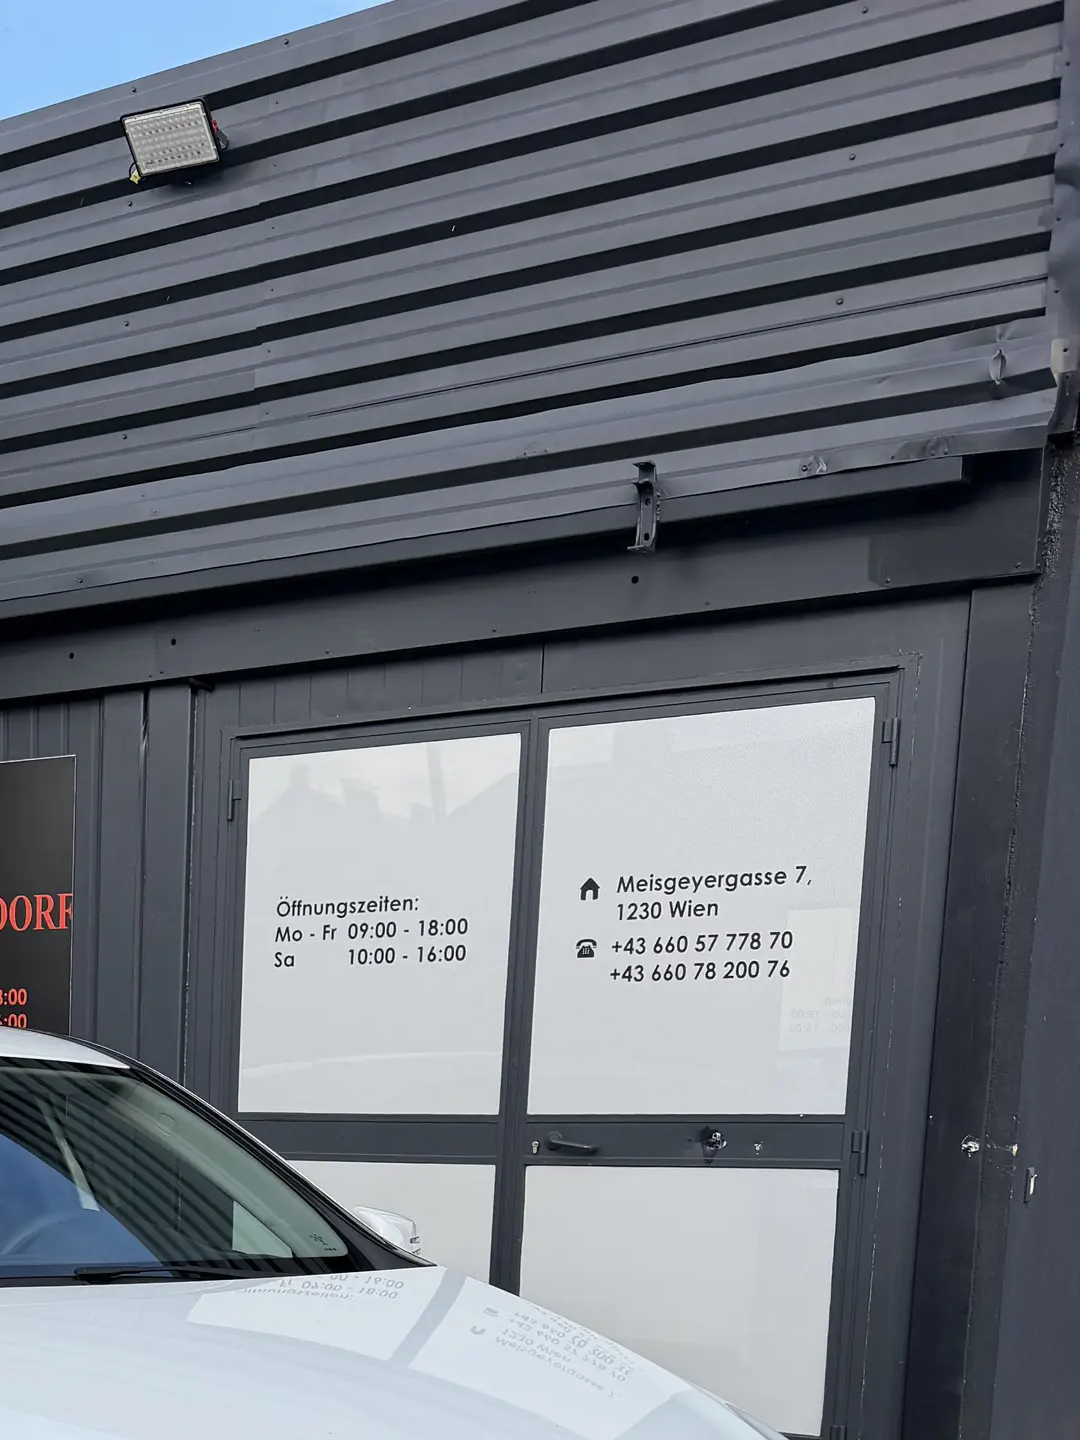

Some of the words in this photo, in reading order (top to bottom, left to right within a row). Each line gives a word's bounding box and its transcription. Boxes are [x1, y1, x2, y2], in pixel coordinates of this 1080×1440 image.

[616, 870, 787, 895] Meisgeyergasse
[795, 865, 812, 886] 7,
[276, 895, 419, 919] Öffnungszeiten:
[617, 901, 662, 921] 1230
[668, 899, 719, 919] Wien
[274, 926, 303, 943] Mo
[322, 924, 337, 941] Fr
[347, 921, 397, 940] 09:00
[418, 917, 468, 937] 18:00
[611, 937, 646, 955] +43
[653, 935, 688, 954] 660
[694, 934, 719, 953] 57
[726, 932, 762, 951] 778
[769, 930, 793, 950] 70
[273, 951, 295, 968] Sa
[348, 947, 396, 965] 10:00
[417, 944, 467, 963] 16:00
[609, 964, 645, 983] +43
[651, 963, 687, 982] 660
[693, 962, 717, 980] 78
[722, 960, 760, 980] 200
[767, 959, 790, 978] 76
